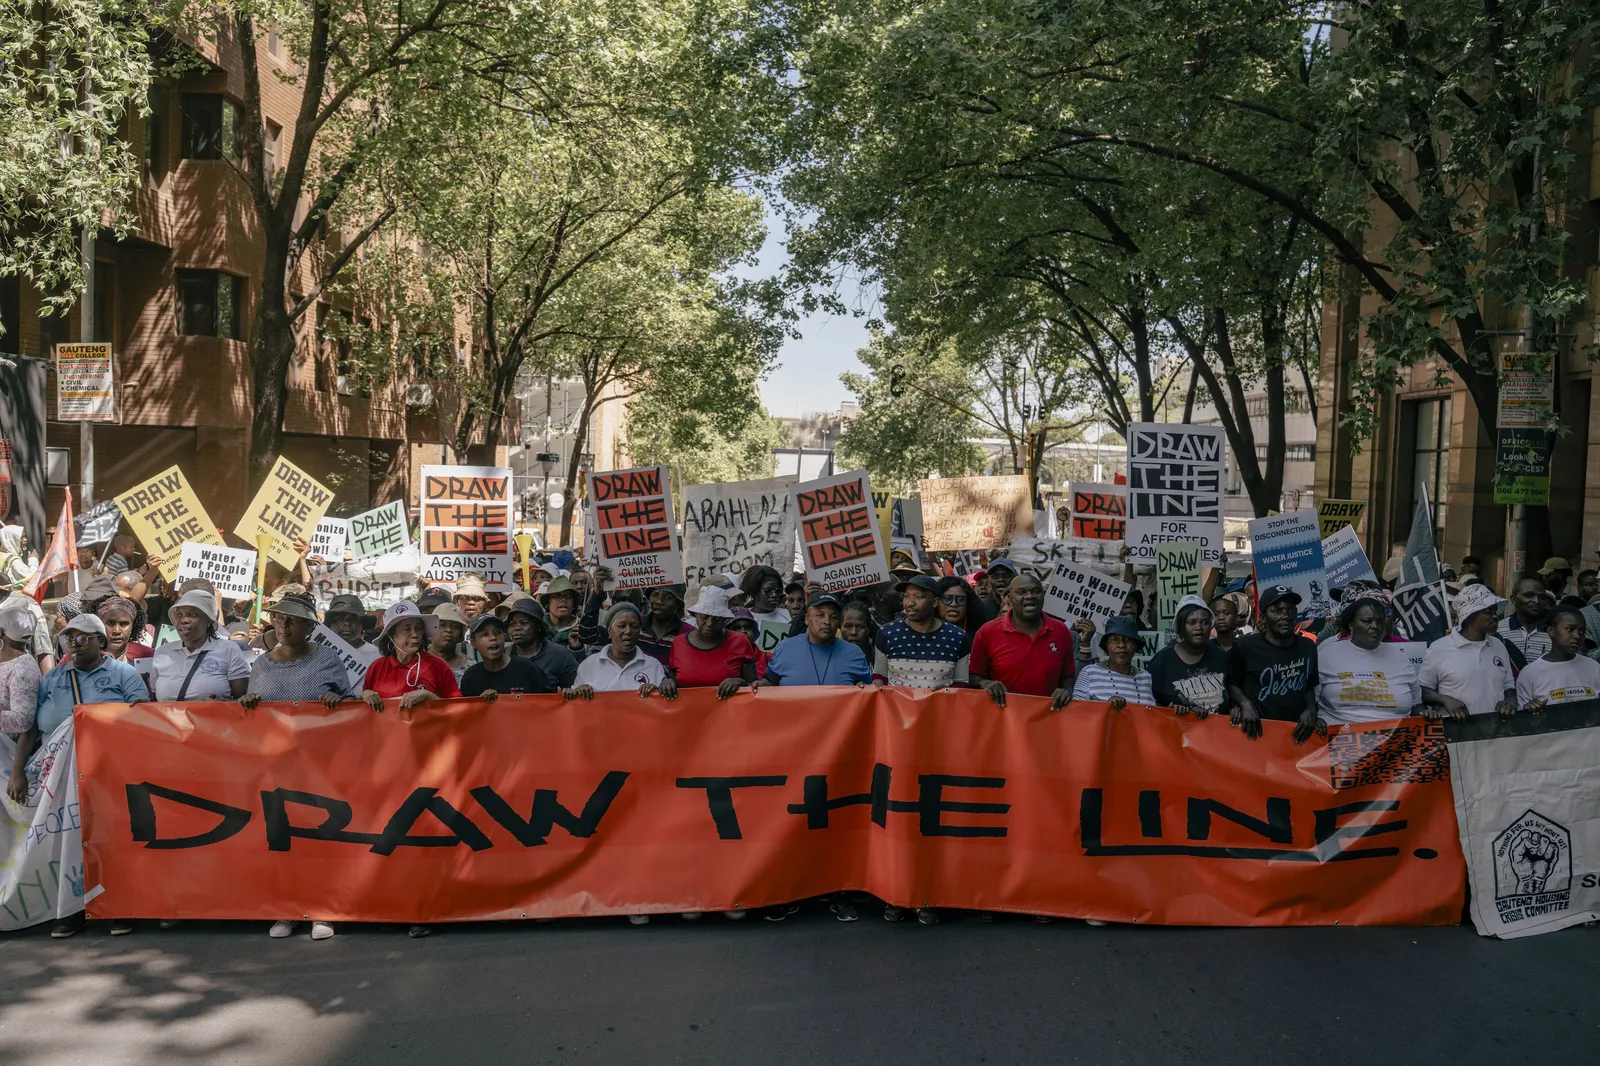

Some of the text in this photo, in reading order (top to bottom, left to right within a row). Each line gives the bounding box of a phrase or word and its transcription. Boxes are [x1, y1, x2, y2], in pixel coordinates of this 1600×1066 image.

[1131, 432, 1220, 460] DRAW
[274, 462, 330, 507] DRAW
[425, 476, 509, 500] DRAW
[594, 467, 660, 501] DRAW
[1131, 463, 1218, 490] THE
[121, 471, 182, 516] DRAW
[275, 486, 312, 522] THE
[797, 478, 862, 516] DRAW
[144, 497, 189, 530] THE
[426, 503, 508, 527] THE
[597, 498, 664, 528] THE
[1131, 493, 1219, 522] LINE
[1320, 504, 1364, 516] DRAW
[258, 504, 303, 542] LINE
[352, 503, 398, 537] DRAW
[802, 506, 868, 541] THE
[1161, 522, 1187, 533] FOR
[1267, 516, 1300, 529] STOP THE
[155, 516, 204, 554] LINE
[355, 524, 402, 554] THE
[426, 530, 508, 555] LINE
[602, 528, 670, 559] LINE
[960, 530, 970, 539] IS
[1254, 524, 1316, 541] DISCONNECTIONS
[1328, 538, 1340, 548] THE
[201, 550, 236, 564] Water
[280, 541, 290, 550] No
[808, 532, 876, 570] LINE
[1262, 548, 1313, 564] WATER JUSTICE
[186, 558, 246, 576] for People
[431, 556, 496, 568] AGAINST
[618, 555, 658, 568] AGAINST
[622, 566, 660, 578] CLIMATE
[824, 563, 868, 580] AGAINST
[1158, 549, 1198, 573] DRAW
[1280, 561, 1298, 570] NOW
[1336, 558, 1358, 574] JUSTICE
[198, 570, 232, 581] before
[619, 576, 666, 588] INJUSTICE
[822, 572, 881, 592] ORRUPTION
[1056, 563, 1084, 584] Free
[1088, 576, 1126, 600] Water
[1159, 574, 1198, 596] THE
[1334, 572, 1348, 584] NOW
[1050, 586, 1116, 618] Basic Needs
[1079, 586, 1095, 599] for
[1066, 604, 1094, 620] Now!
[342, 654, 366, 676] Fall
[125, 770, 631, 856] DRAW
[676, 762, 1012, 840] THE
[1080, 788, 1439, 862] LINE.
[1498, 832, 1513, 858] NOTHING
[1512, 823, 1525, 835] FOR
[1536, 820, 1560, 840] WITHOUT
[1558, 838, 1568, 850] US!
[1495, 891, 1570, 912] GAUTENG HOUSING
[1500, 900, 1570, 924] CRISIS COMMITTEE
